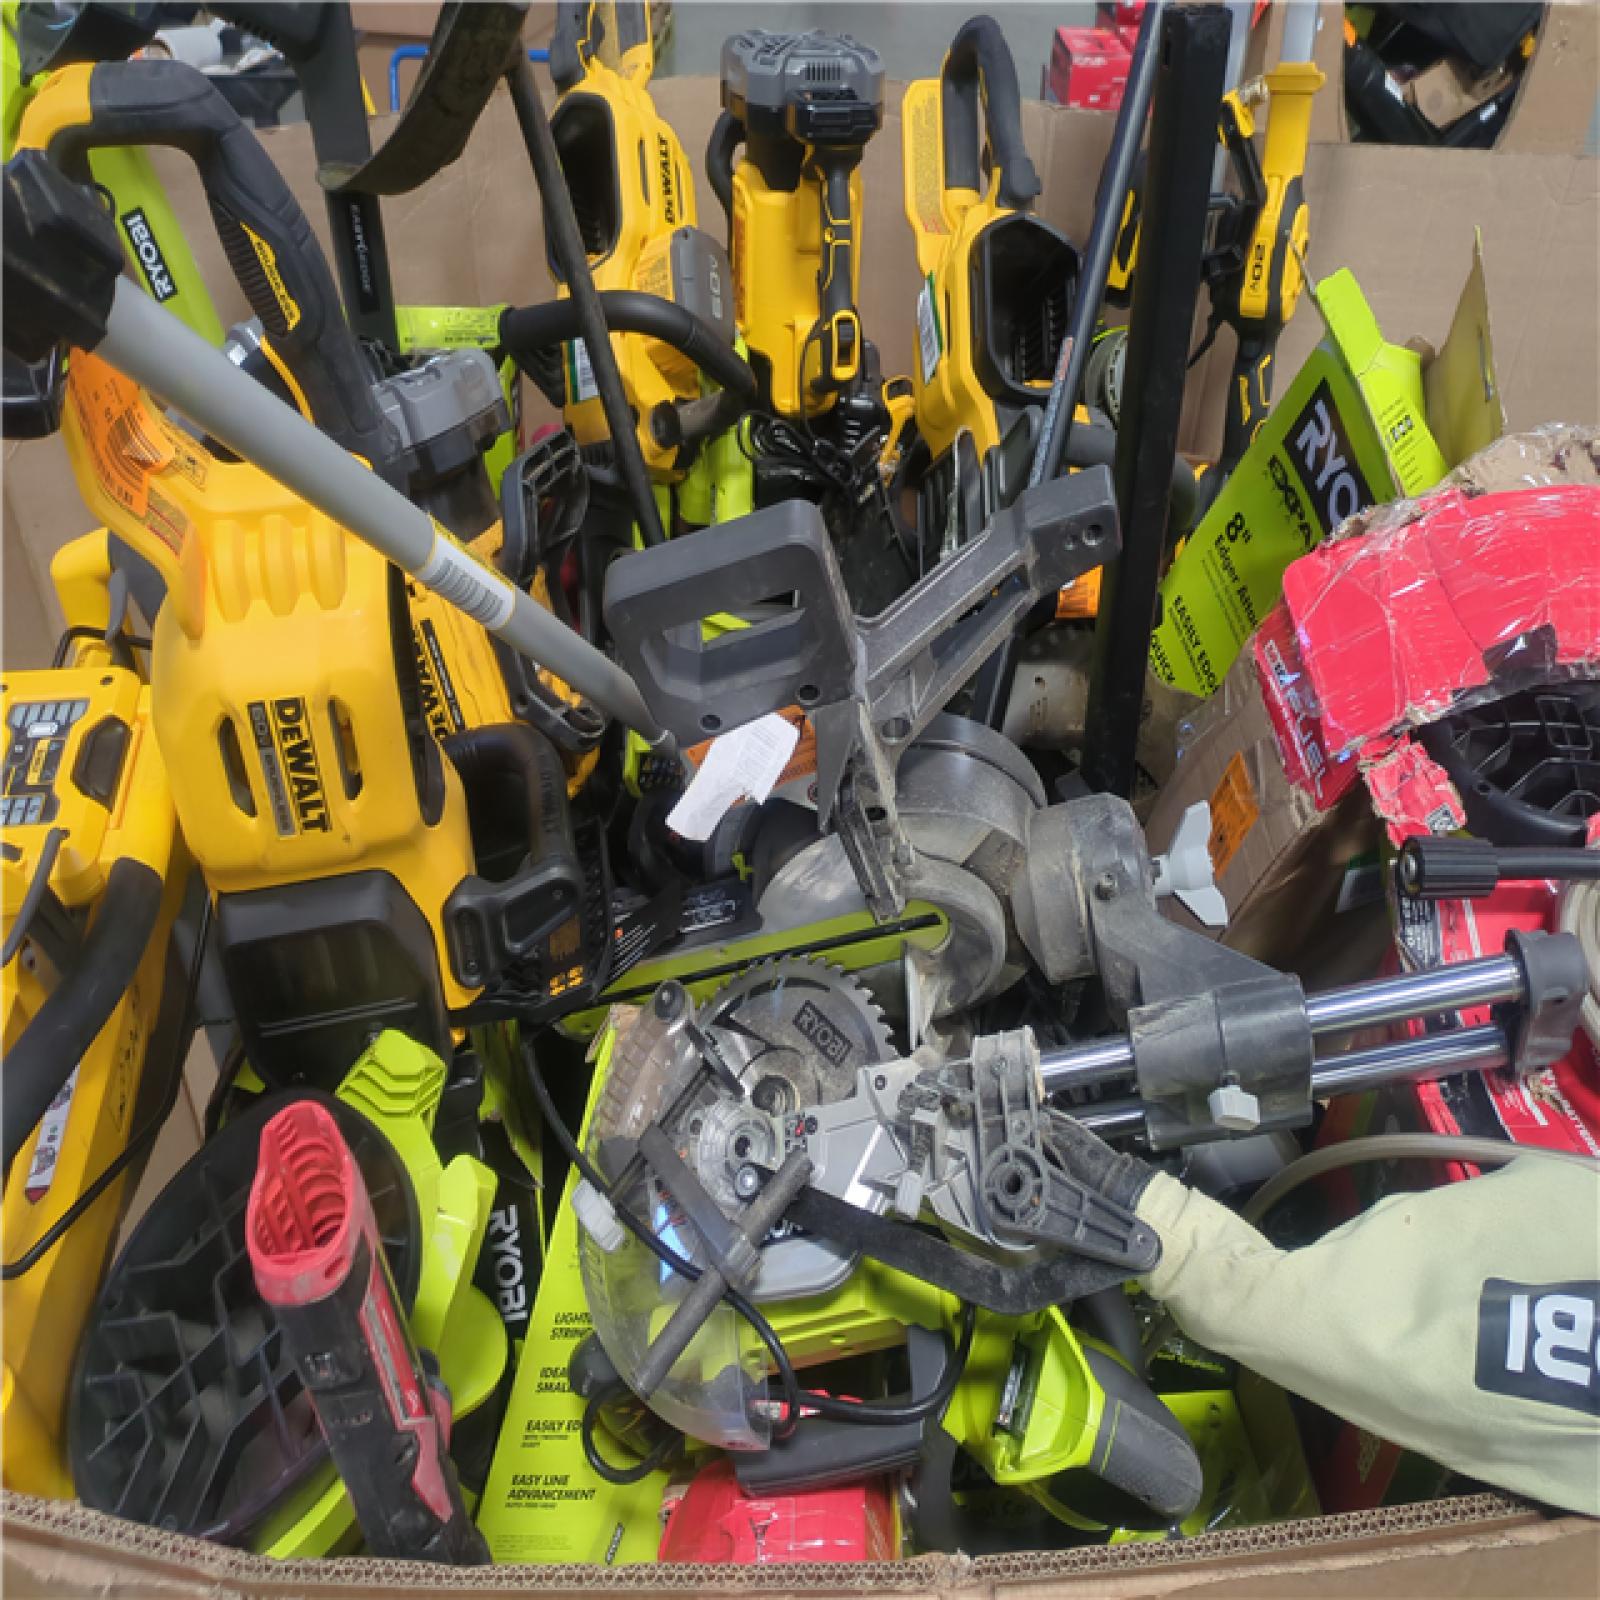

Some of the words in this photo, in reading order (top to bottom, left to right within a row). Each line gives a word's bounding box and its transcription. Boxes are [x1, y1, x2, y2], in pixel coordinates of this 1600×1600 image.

[127, 213, 173, 299] RYOBI
[1296, 399, 1364, 530] RYO
[274, 697, 333, 833] DEWALT
[799, 1006, 850, 1059] RYOBI
[490, 1204, 528, 1322] RYOBI
[539, 1366, 569, 1378] IDEA
[1504, 1293, 1600, 1388] BI
[535, 1381, 574, 1393] SMAL
[507, 1489, 596, 1501] ADVANCEMENT
[511, 1474, 541, 1486] EASY
[543, 1474, 570, 1486] LINE
